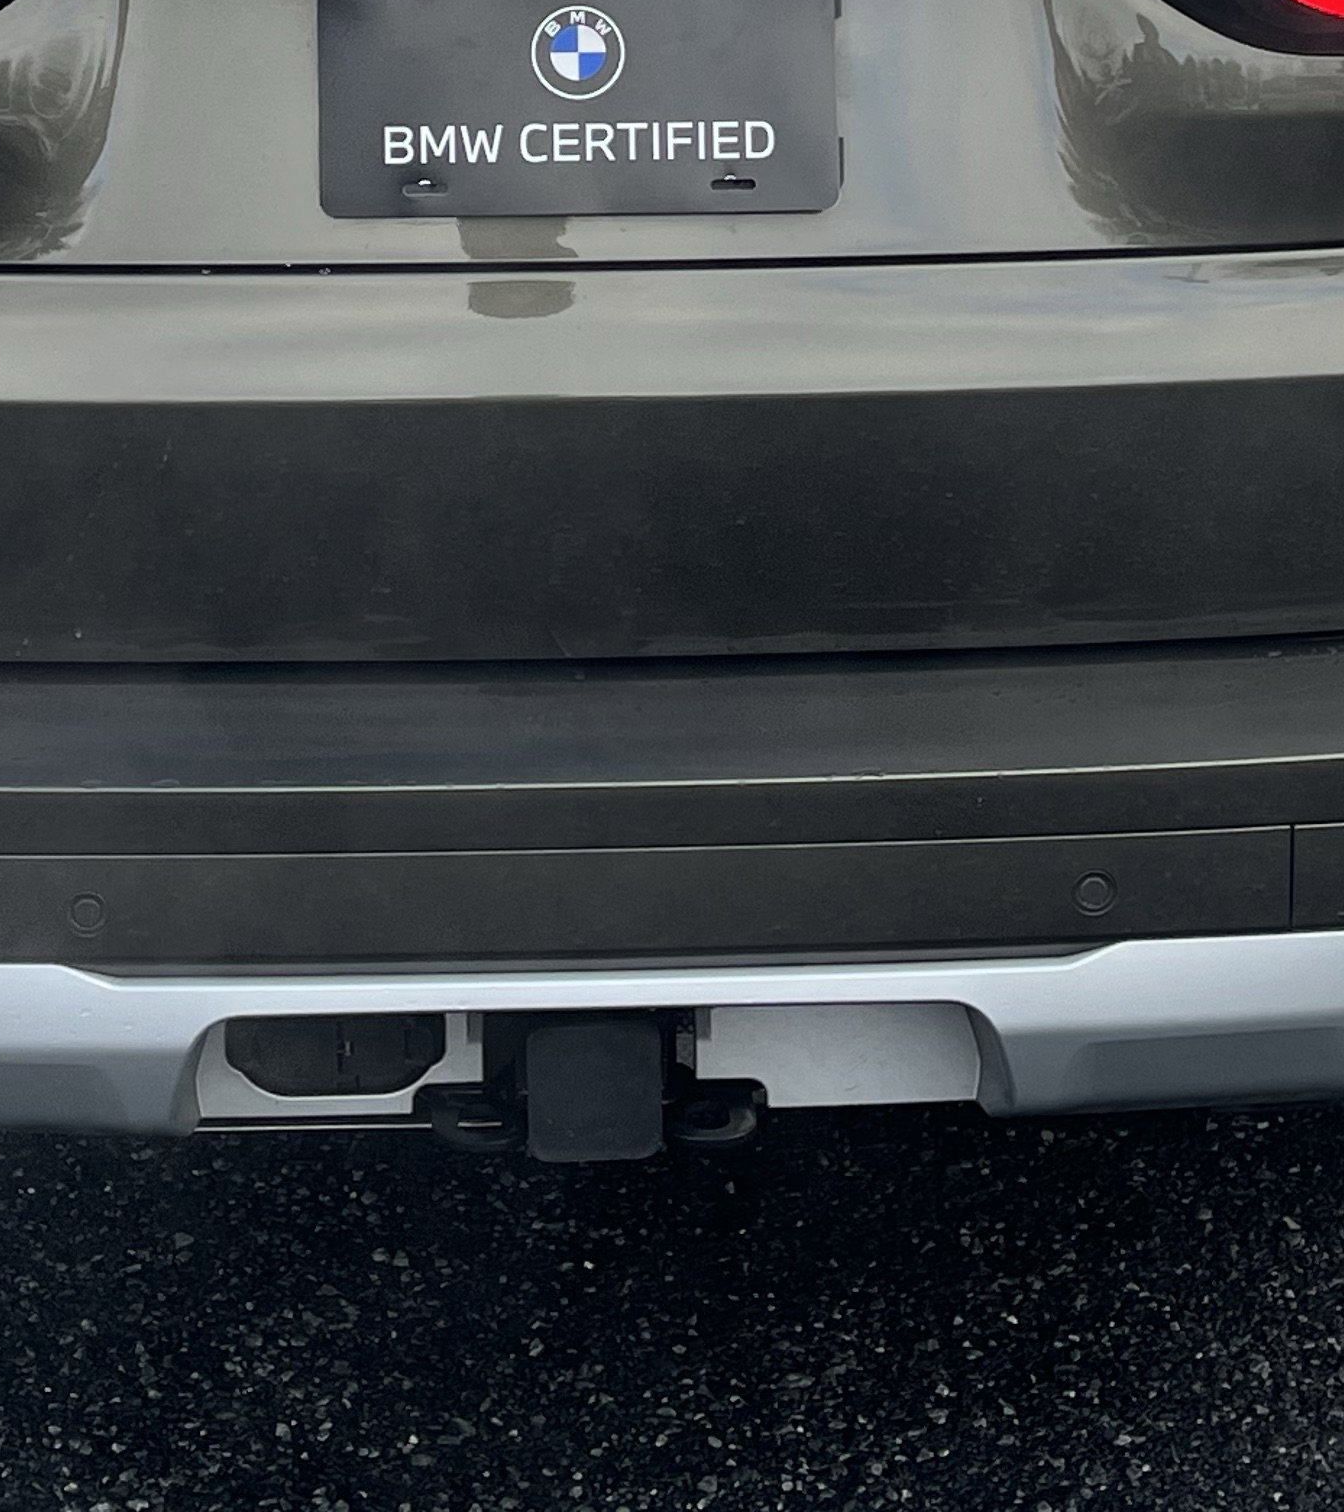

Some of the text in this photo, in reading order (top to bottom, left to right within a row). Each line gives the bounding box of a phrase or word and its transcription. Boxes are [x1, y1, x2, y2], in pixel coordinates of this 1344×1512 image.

[544, 10, 612, 38] BMW
[382, 119, 776, 165] BMW CERTIFIED
